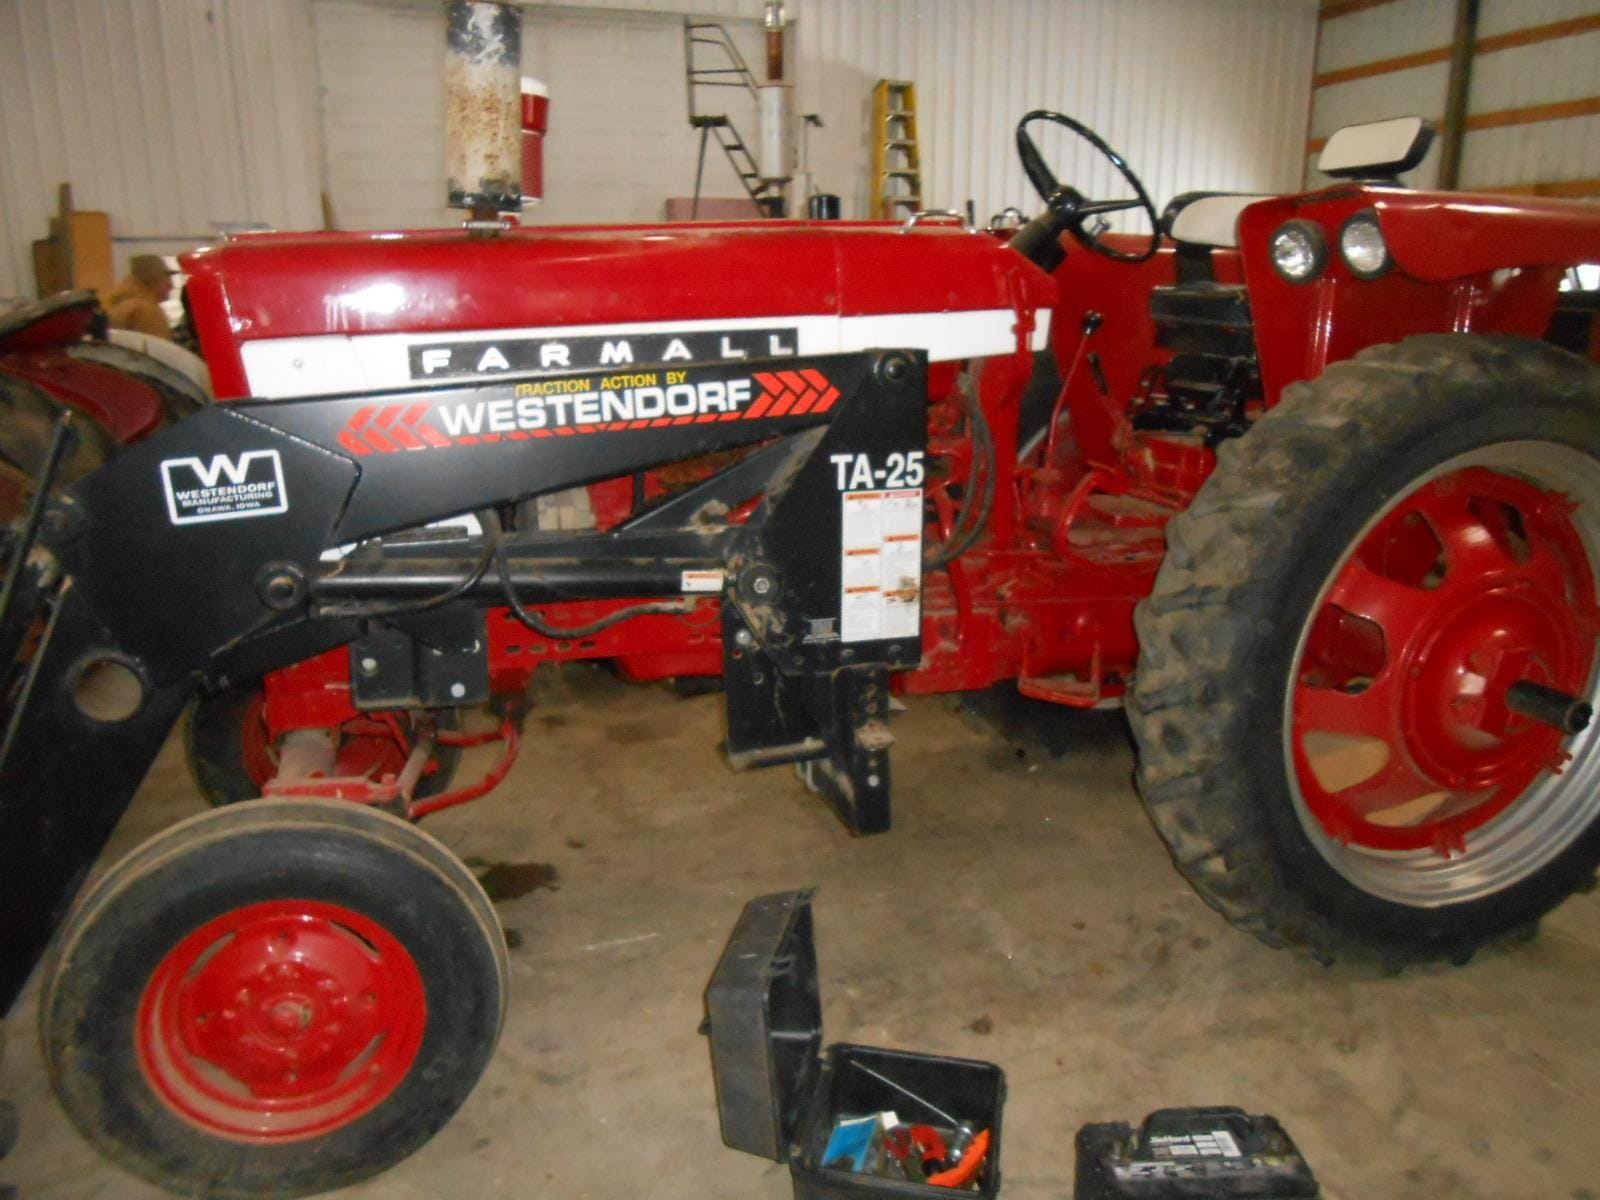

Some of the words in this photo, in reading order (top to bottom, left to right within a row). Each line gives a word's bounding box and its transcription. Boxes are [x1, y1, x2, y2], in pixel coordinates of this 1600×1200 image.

[422, 334, 793, 374] FARMALL
[601, 373, 657, 390] ACTION
[666, 371, 686, 385] BY
[438, 378, 751, 437] WESTENDORF
[830, 450, 924, 491] TA-25
[175, 481, 276, 500] WESTENDORF
[182, 490, 274, 508] MANUFACTURING
